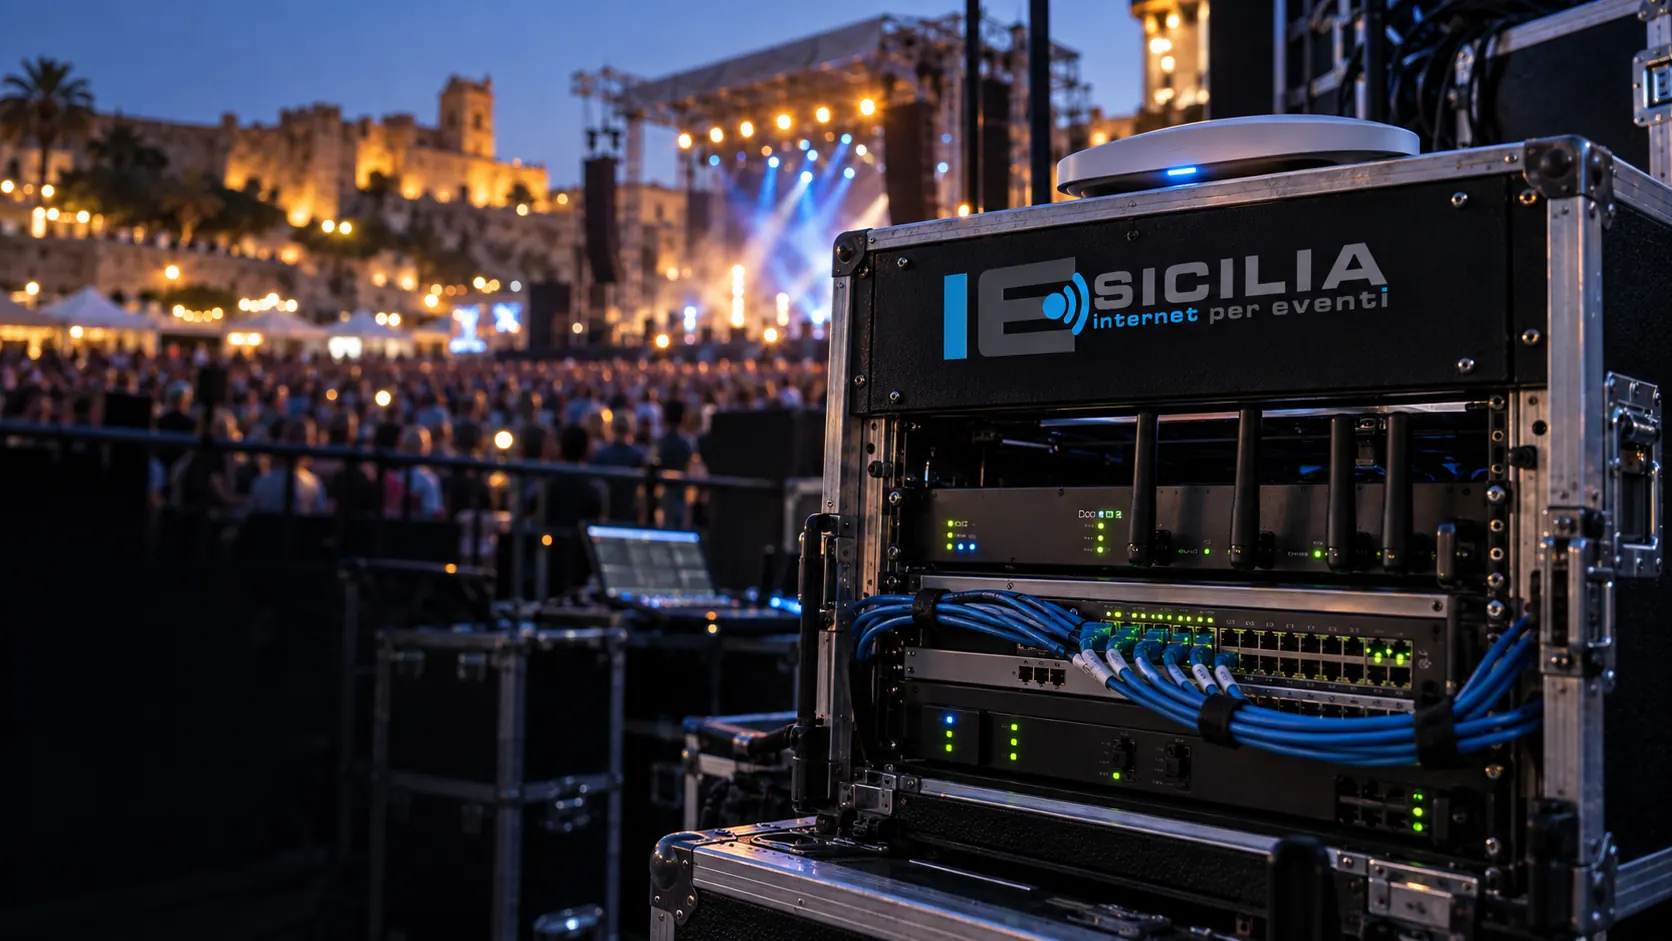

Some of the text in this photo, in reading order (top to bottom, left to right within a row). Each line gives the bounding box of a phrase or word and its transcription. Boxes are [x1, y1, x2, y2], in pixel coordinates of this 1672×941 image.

[1094, 242, 1388, 310] SICILIA
[1093, 287, 1388, 329] internet per eventi
